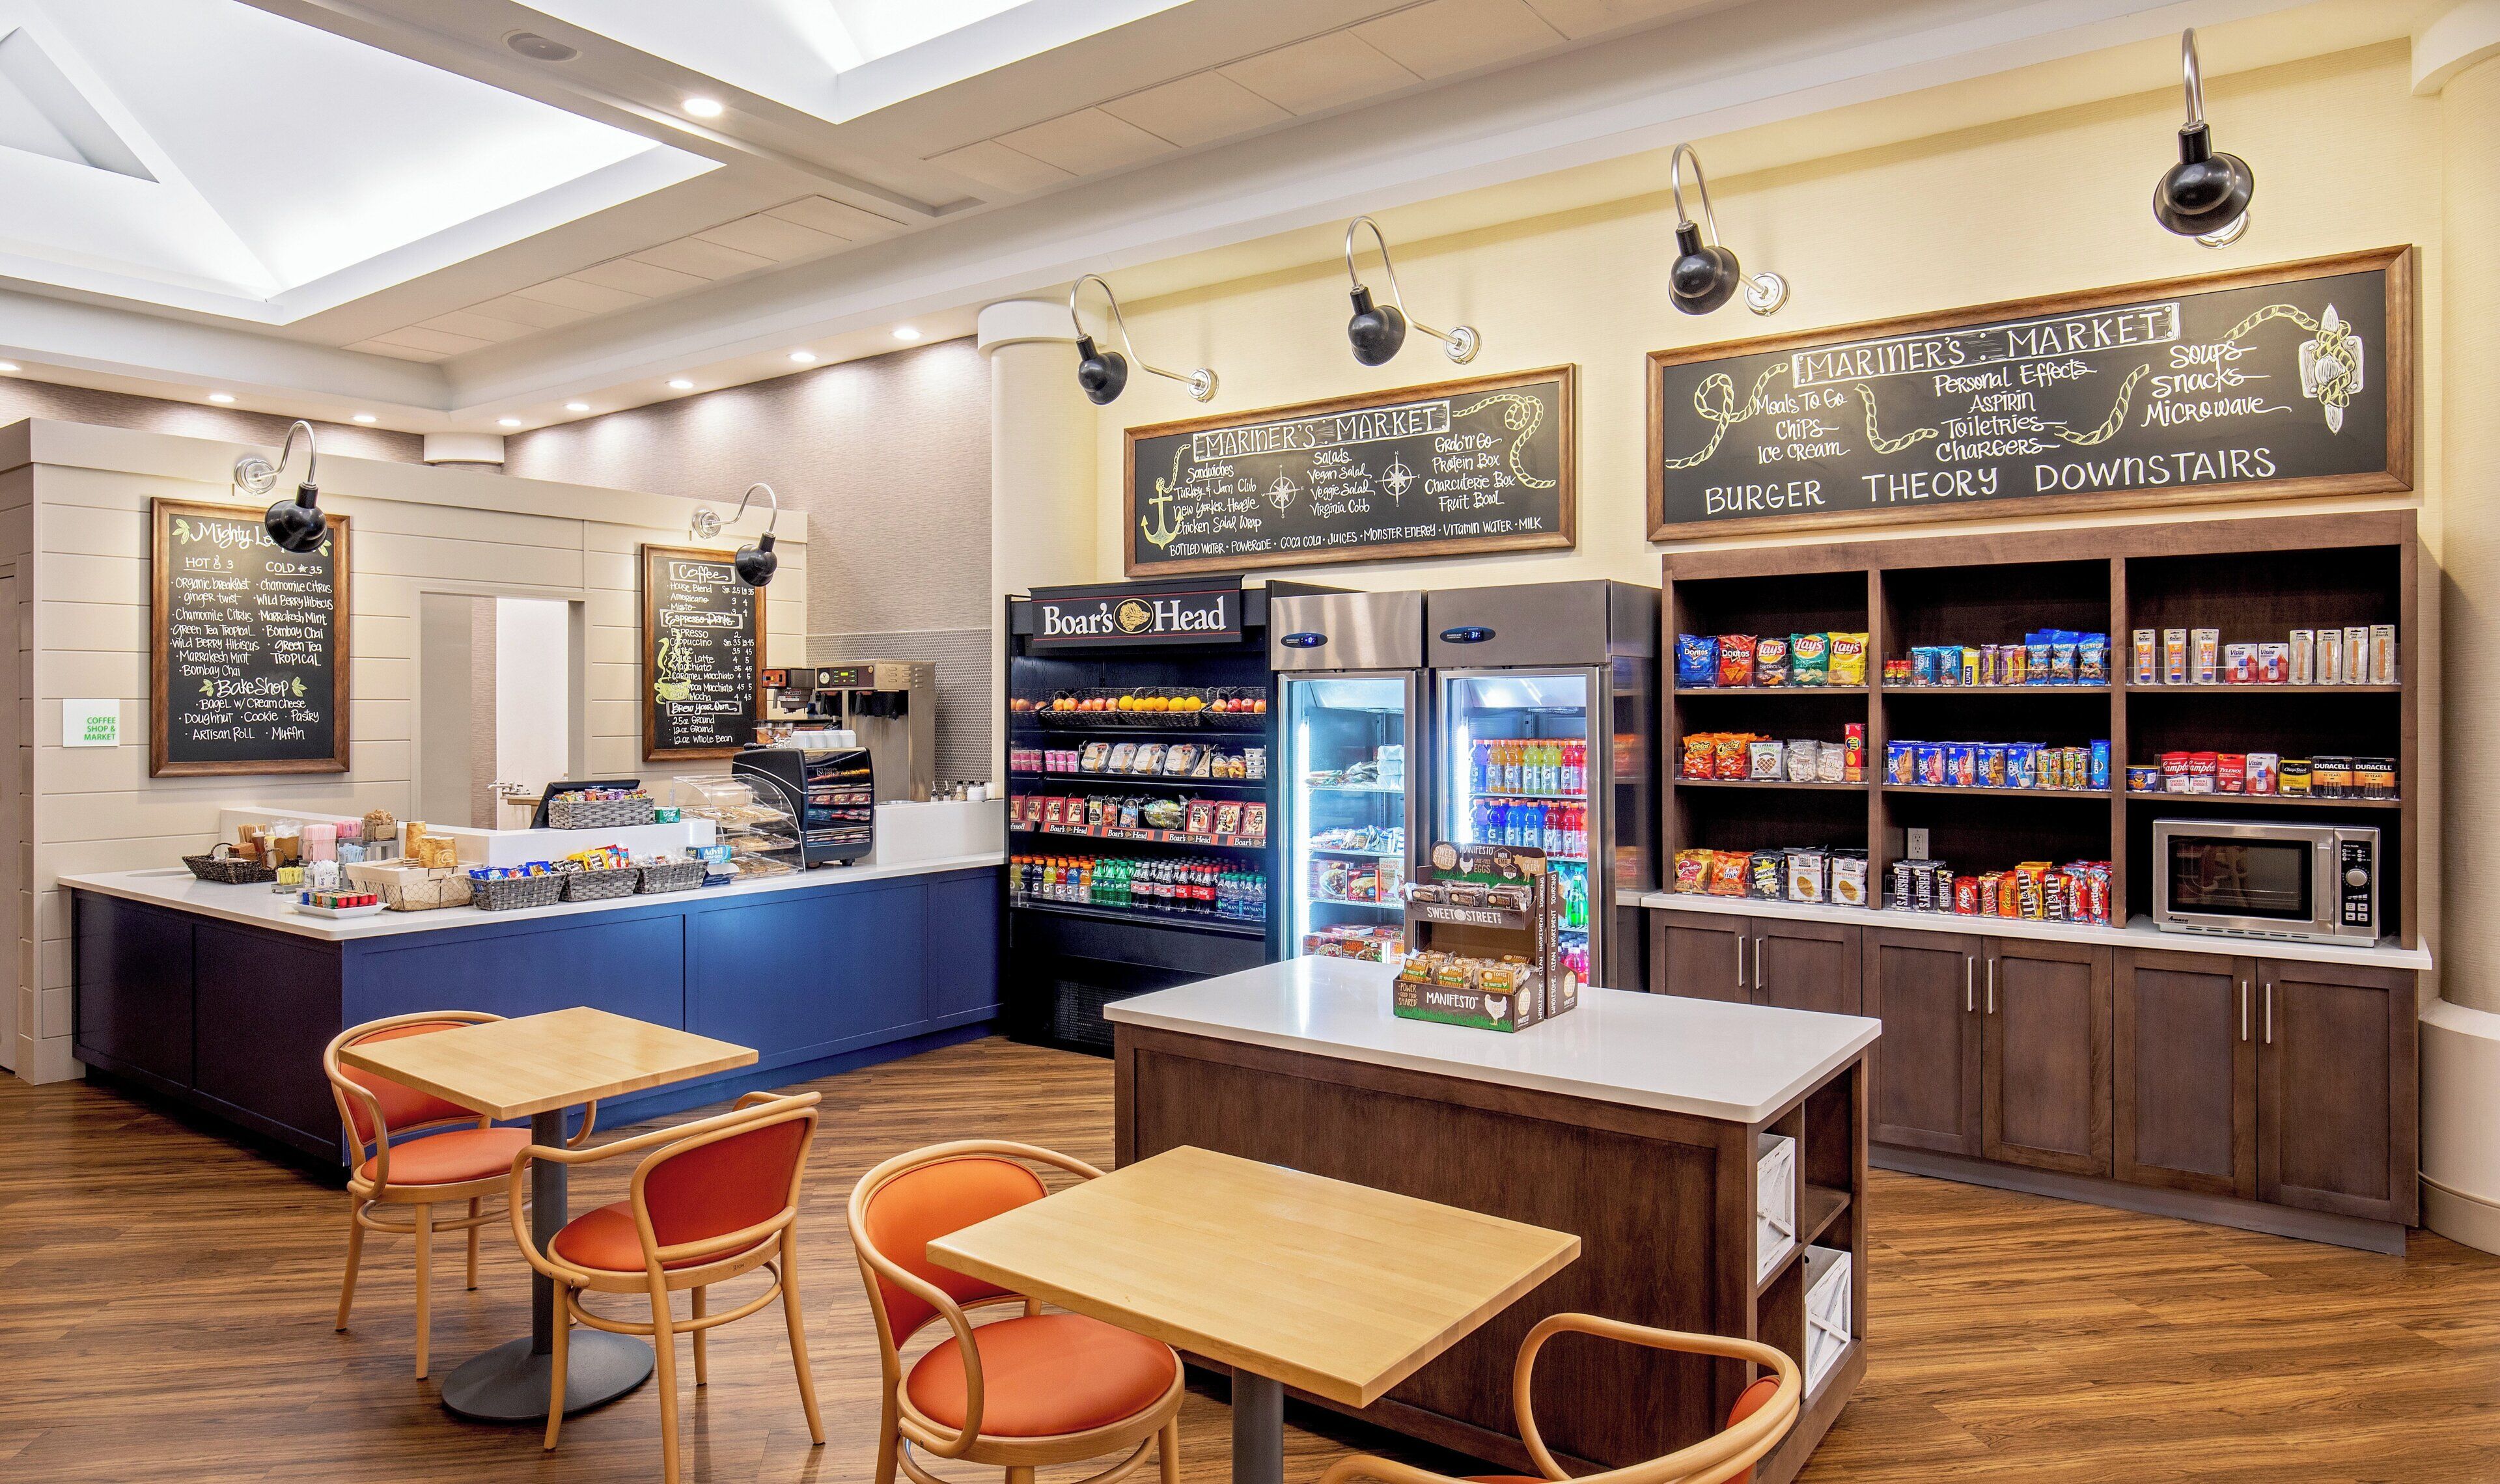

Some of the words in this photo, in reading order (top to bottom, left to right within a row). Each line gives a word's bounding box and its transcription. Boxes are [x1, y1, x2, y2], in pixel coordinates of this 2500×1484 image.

[1805, 337, 1965, 383] MARINER'S
[2007, 311, 2163, 357] MARKET
[2170, 341, 2257, 369] Soups
[1933, 372, 2012, 397] Personal
[2020, 359, 2098, 388] Effects
[1755, 393, 1799, 415] Meals
[1824, 389, 1848, 407] Go
[1206, 424, 1316, 458] MARINER'S
[1337, 407, 1437, 441] MARKET
[1312, 448, 1352, 465] Salads
[1478, 453, 1500, 469] Box
[1758, 445, 1784, 464] Ice
[1307, 469, 1337, 486] Vegan
[1339, 463, 1372, 480] Salad
[1493, 471, 1516, 487] Box
[1704, 480, 1826, 515] BURGER
[1862, 467, 1998, 502] THEORY
[2035, 447, 2276, 493] DOWNSTAIRS
[1238, 478, 1257, 493] Club
[1310, 486, 1340, 501] Veggie
[1341, 482, 1375, 497] Salad
[1348, 499, 1370, 513] Cobb
[1213, 517, 1237, 532] Salad
[1327, 531, 1357, 545] JUICES
[1518, 517, 1542, 530] MILK
[190, 522, 255, 549] Mighty
[186, 557, 211, 569] HOT
[226, 560, 234, 569] 3
[266, 561, 295, 573] COLD
[678, 564, 729, 584] Coffee
[693, 584, 712, 594] Blend
[214, 593, 242, 605] twist
[305, 612, 327, 626] Mint
[1042, 602, 1114, 636] Boar's
[1153, 595, 1227, 633] Head
[206, 625, 219, 636] Tea
[266, 625, 303, 639] Bombay
[304, 627, 324, 639] Chai
[1758, 642, 1784, 657] Lay's
[1796, 639, 1824, 652] Lay's
[1833, 640, 1861, 654] Lay's
[230, 652, 251, 665] Mint
[1721, 650, 1750, 658] Doritos
[183, 665, 220, 678] Bombay
[222, 666, 241, 677] Chai
[243, 710, 279, 722] Cookie
[271, 726, 305, 741] Muffin
[1049, 823, 1066, 833] Boar's
[1073, 825, 1087, 834] Head
[1107, 829, 1124, 838] Boar's
[1132, 830, 1148, 840] Head
[704, 847, 723, 855] Advil
[1434, 845, 1456, 858] SWEET
[1433, 855, 1457, 867] STREET
[1523, 863, 1540, 872] DAIRY
[1473, 864, 1491, 874] EGGS
[1426, 906, 1454, 920] SWEET
[1465, 910, 1498, 924] STREET
[1426, 991, 1477, 1010] MANIFESTO
